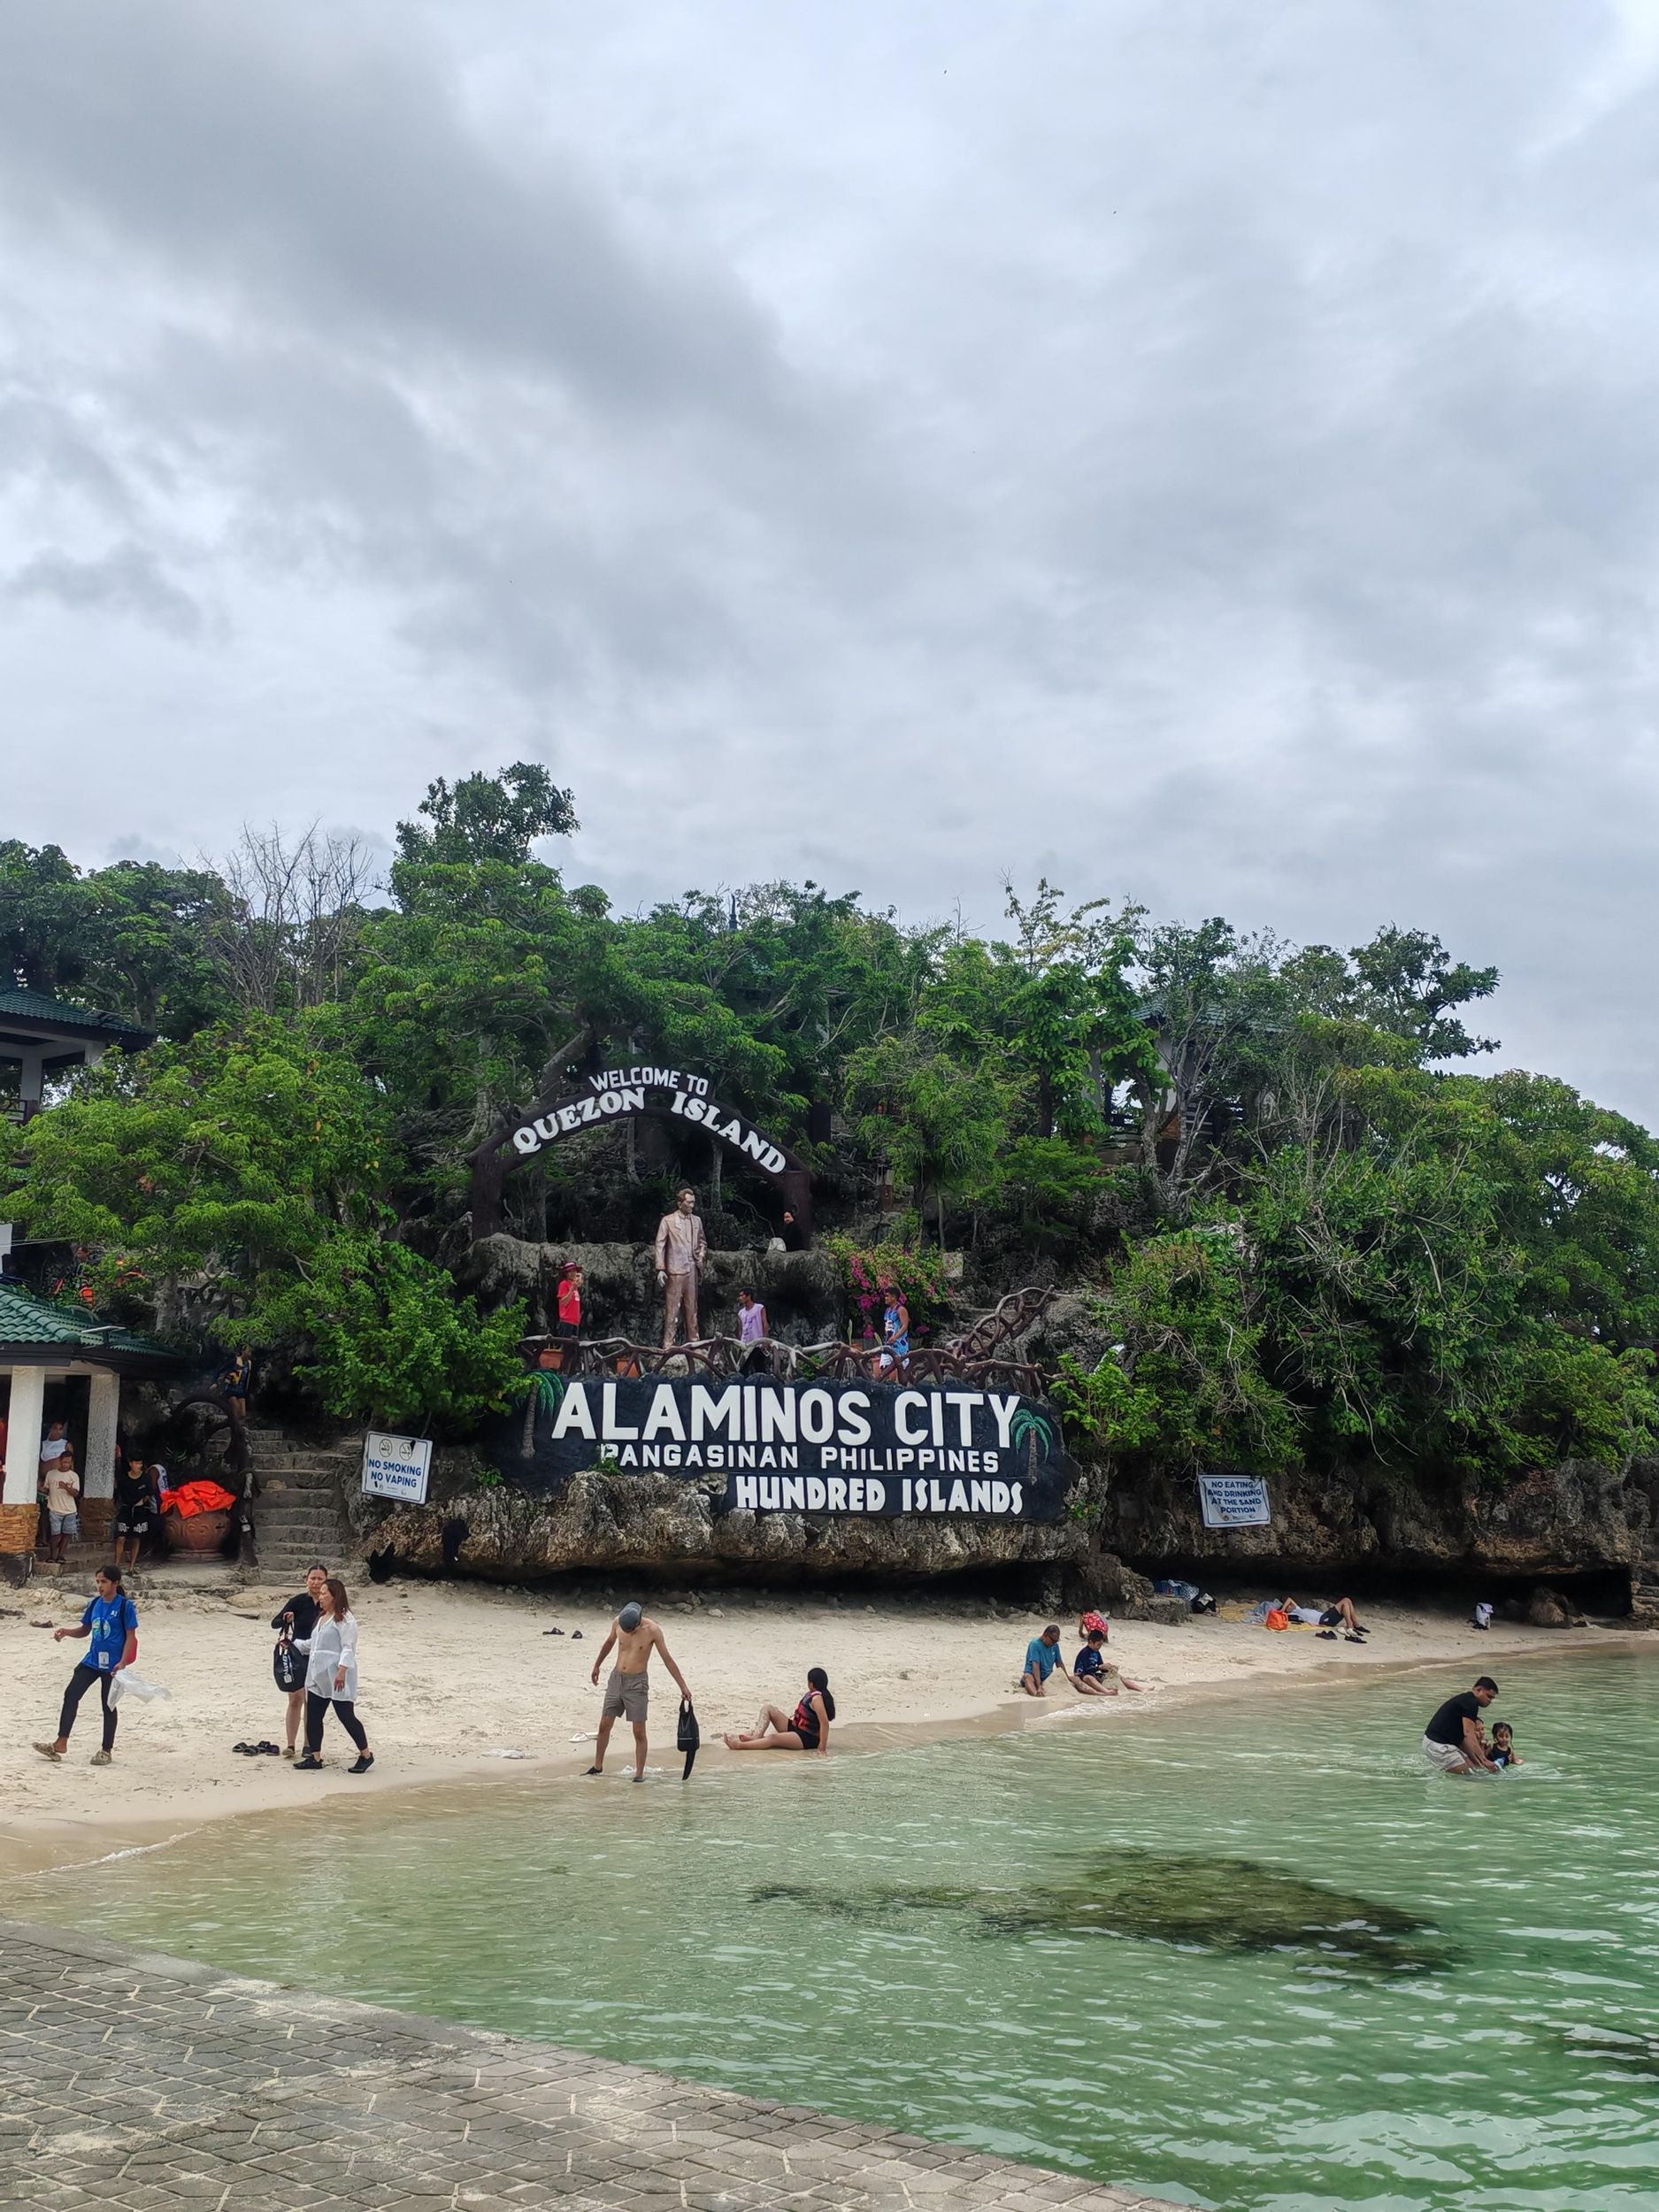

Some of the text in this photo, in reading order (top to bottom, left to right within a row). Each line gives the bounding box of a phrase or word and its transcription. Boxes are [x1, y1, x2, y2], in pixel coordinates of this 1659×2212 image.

[588, 1066, 709, 1096] WELCOME TO
[512, 1087, 787, 1174] QUEZON ISLAND
[550, 1381, 1021, 1449] ALAMINOS CITY
[368, 1459, 421, 1476] NO SMOKING
[600, 1443, 1000, 1473] PANGASINAN PHILIPPINES
[371, 1471, 417, 1487] NO VAPING
[1224, 1488, 1262, 1497] DRINKING
[735, 1475, 1024, 1517] HUNDRED ISLANDS
